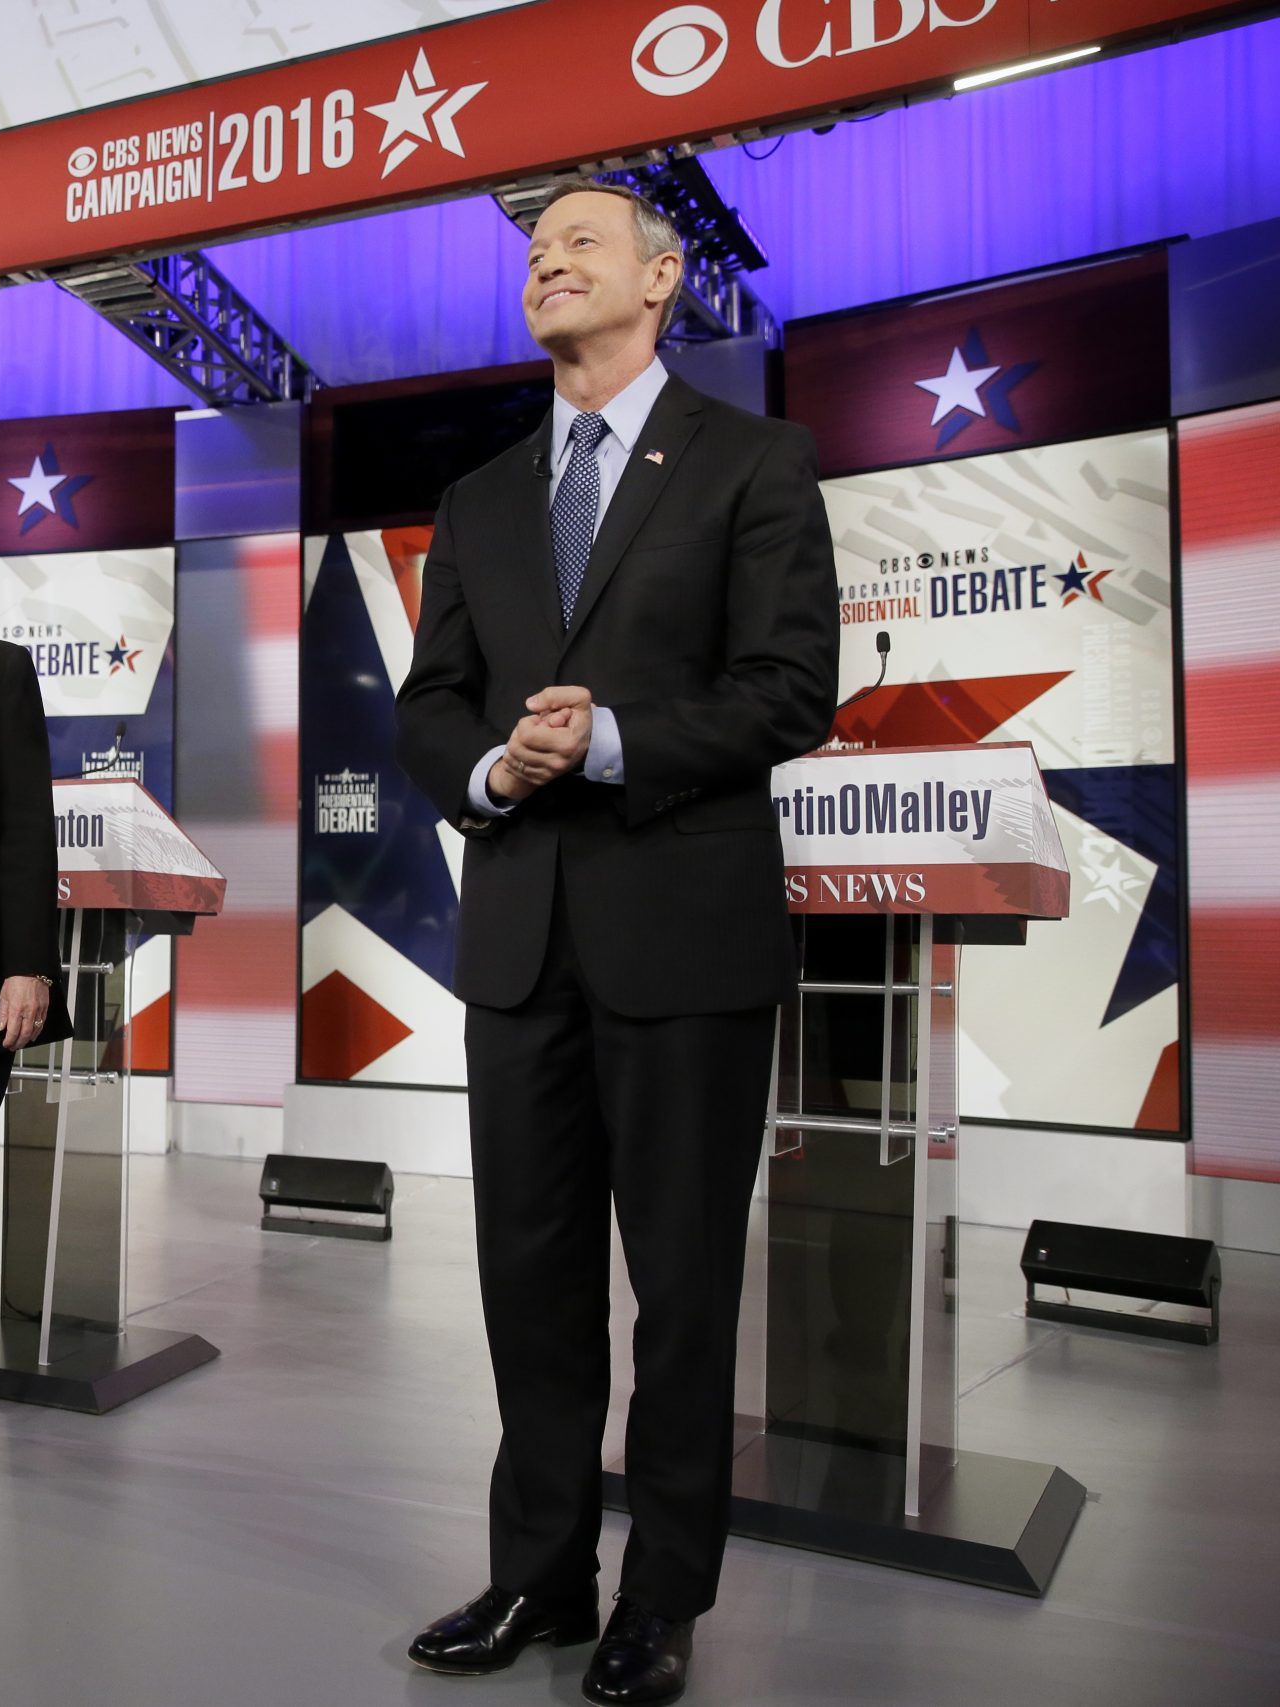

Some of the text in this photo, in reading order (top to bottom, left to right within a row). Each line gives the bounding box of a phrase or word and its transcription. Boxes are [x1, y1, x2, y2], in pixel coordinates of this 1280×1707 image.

[102, 121, 203, 172] CBS NEWS
[217, 88, 355, 191] 2016
[66, 157, 203, 224] CAMPAIGN
[880, 546, 990, 575] CBS NEWS
[839, 578, 921, 600] OCRATIC
[930, 564, 1047, 619] DEBATE
[840, 597, 922, 625] SIDENTIAL
[29, 624, 63, 638] NEWS
[319, 808, 376, 833] DEBATE
[773, 781, 992, 840] rtinOMalley
[56, 809, 104, 848] nton
[818, 873, 926, 903] NEWS
